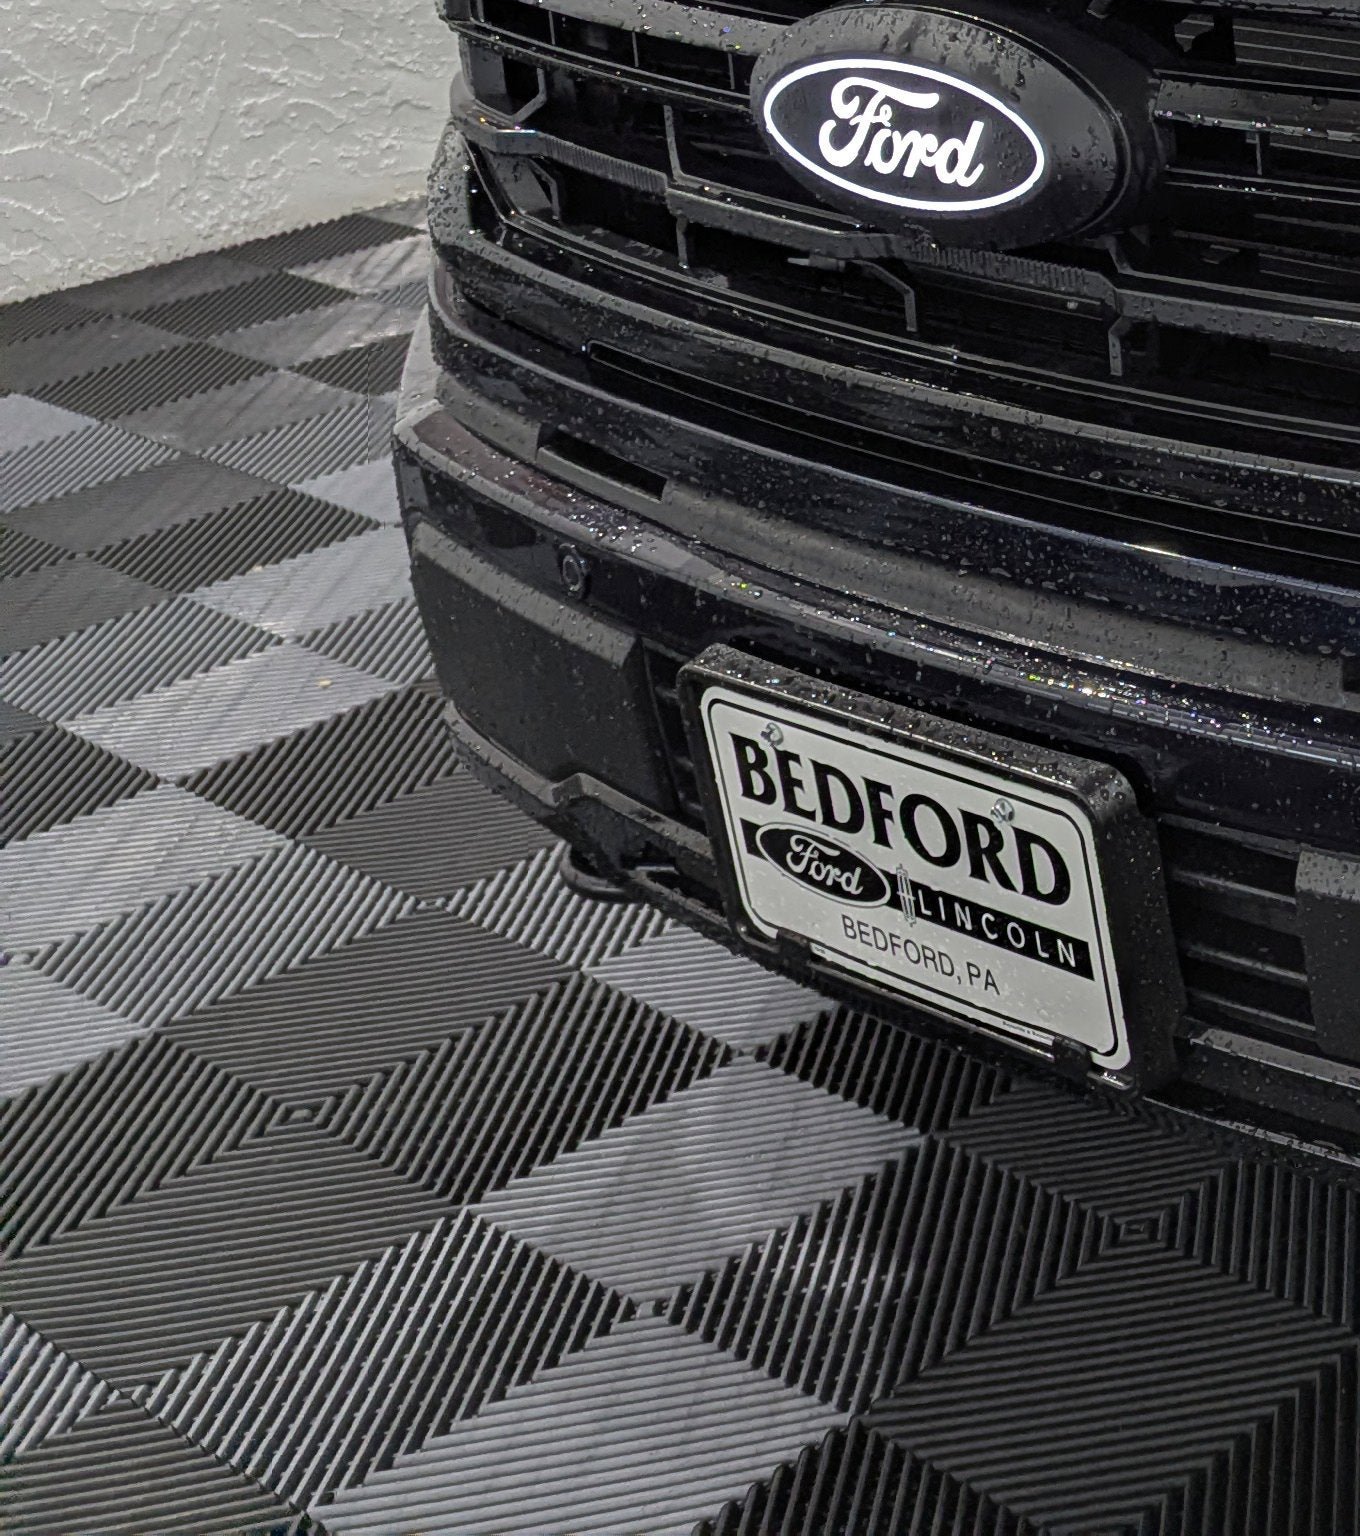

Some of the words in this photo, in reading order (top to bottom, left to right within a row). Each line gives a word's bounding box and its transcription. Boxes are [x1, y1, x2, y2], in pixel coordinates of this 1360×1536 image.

[818, 76, 985, 188] Ford
[729, 732, 1072, 906] BEDFORD
[785, 834, 864, 896] Ford
[841, 914, 961, 985] BEDFORD,
[968, 962, 1001, 996] PA
[919, 893, 1077, 968] LINCOLN
